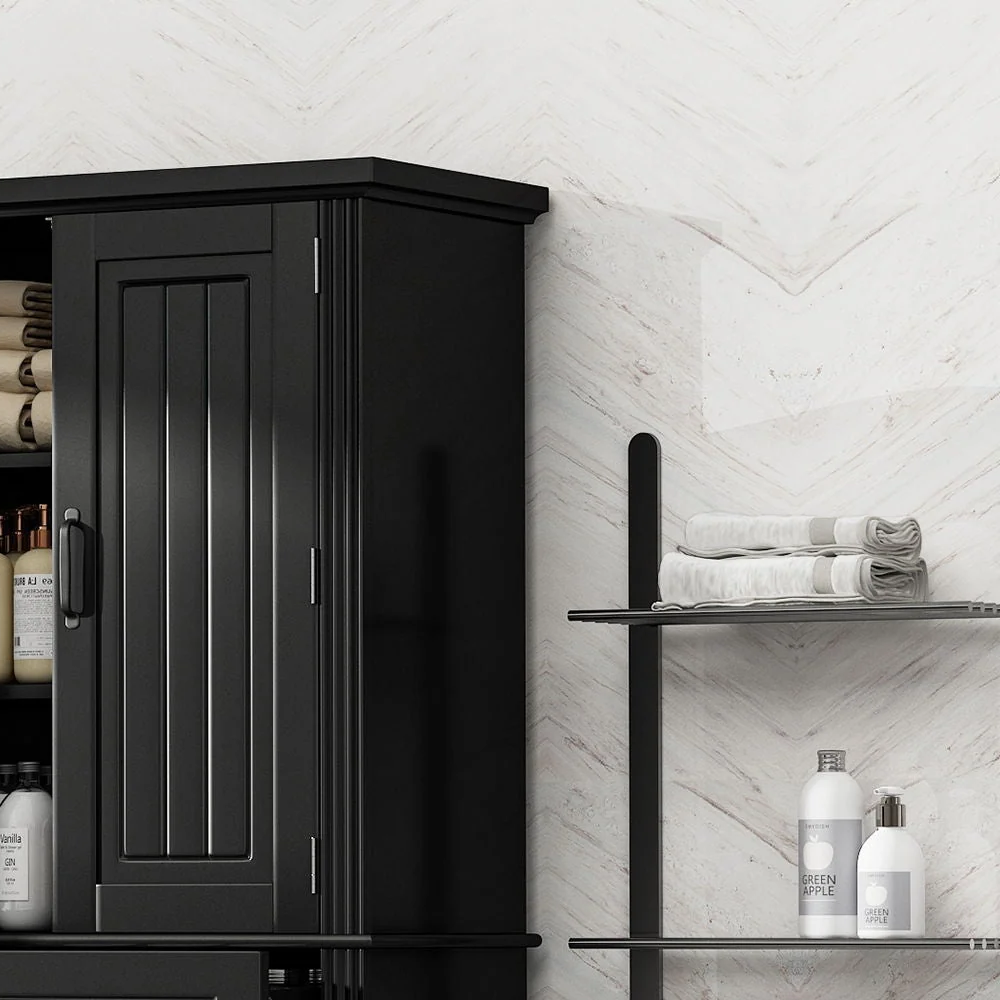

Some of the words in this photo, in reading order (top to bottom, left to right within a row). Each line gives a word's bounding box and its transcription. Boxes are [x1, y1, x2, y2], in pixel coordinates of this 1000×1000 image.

[0, 833, 22, 844] Vanilla
[4, 857, 16, 867] GIN
[802, 874, 836, 885] GREEN
[803, 885, 835, 896] APPLE
[864, 908, 889, 916] GREEN
[865, 916, 888, 924] APPLE
